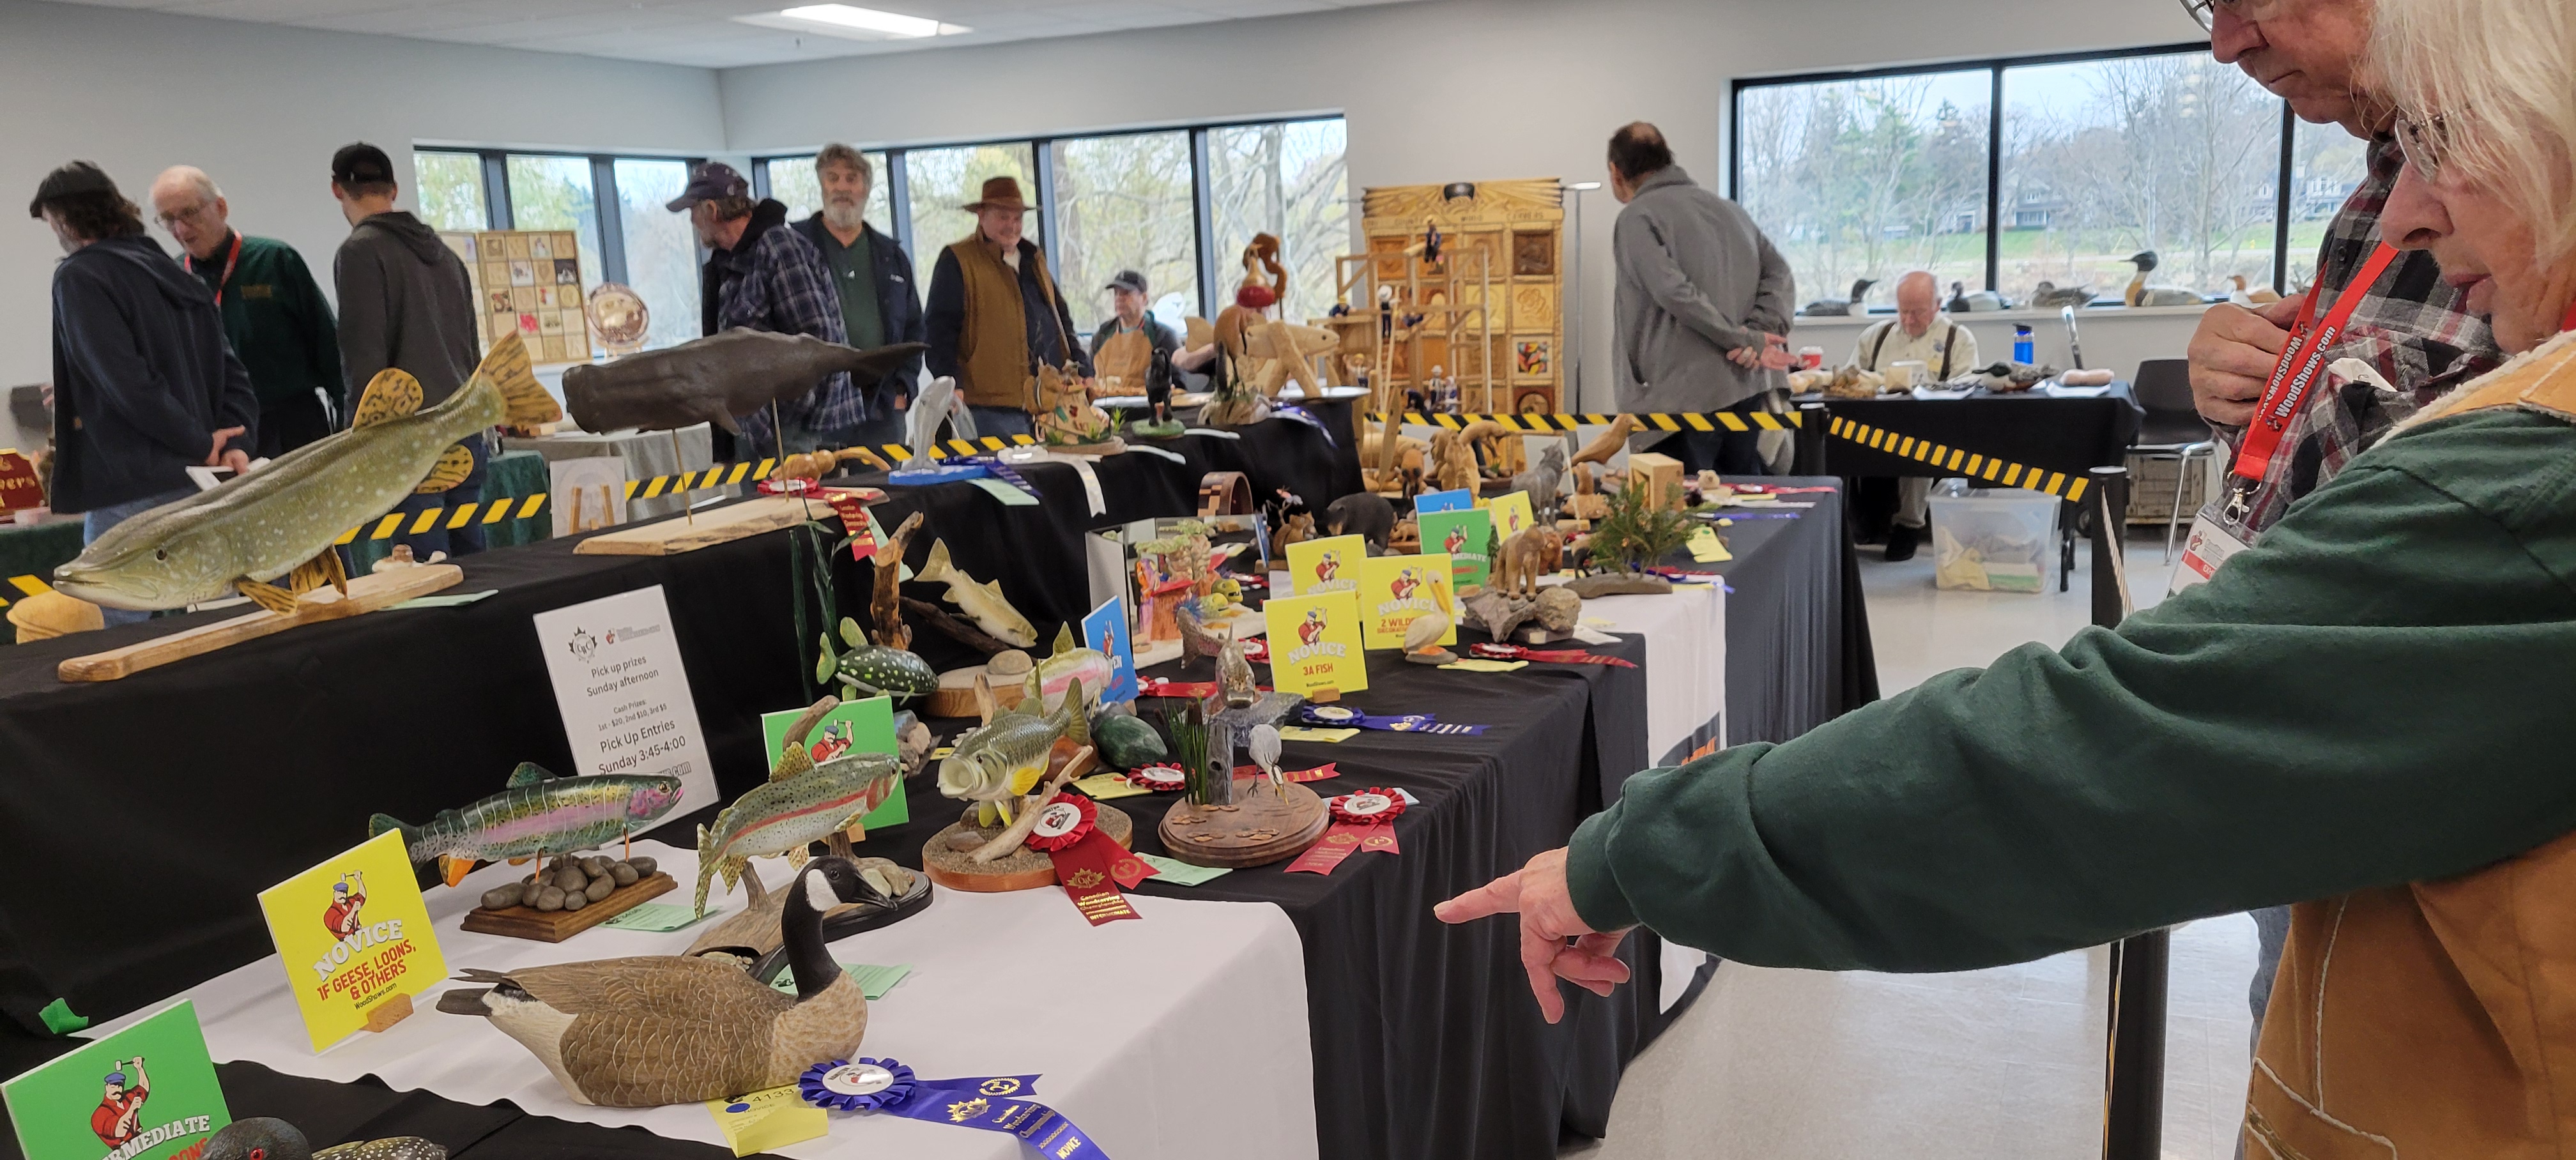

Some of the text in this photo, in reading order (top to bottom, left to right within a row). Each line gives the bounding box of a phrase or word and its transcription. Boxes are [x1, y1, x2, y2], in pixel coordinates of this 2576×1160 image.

[2257, 336, 2303, 422] WoodShows.
[2275, 326, 2336, 418] WoodShows.com
[591, 656, 647, 678] Pick up prizes
[1287, 641, 1347, 665] NOVICE
[587, 669, 659, 697] Sunday afternoon
[1303, 662, 1333, 676] 3A FISH
[598, 723, 608, 731] 1st
[611, 717, 625, 727] $20,
[625, 712, 636, 722] 2nd
[636, 709, 649, 719] $10,
[650, 705, 659, 715] 3rd
[659, 702, 667, 712] $5
[613, 699, 647, 714] Cash Prizes:
[600, 720, 675, 753] Pick Up Entries
[598, 755, 638, 775] Sunday
[639, 735, 686, 761] 3:45-4:00
[313, 919, 403, 982] NOVICE
[332, 961, 375, 993] GEESE,
[374, 938, 417, 970] LOONS,
[350, 959, 407, 1000] & OTHERS
[354, 982, 397, 1010] WoodShows.com
[753, 1088, 795, 1103] 4133
[101, 1115, 210, 1160] RMEDIATE
[1056, 1136, 1082, 1160] NOVICE
